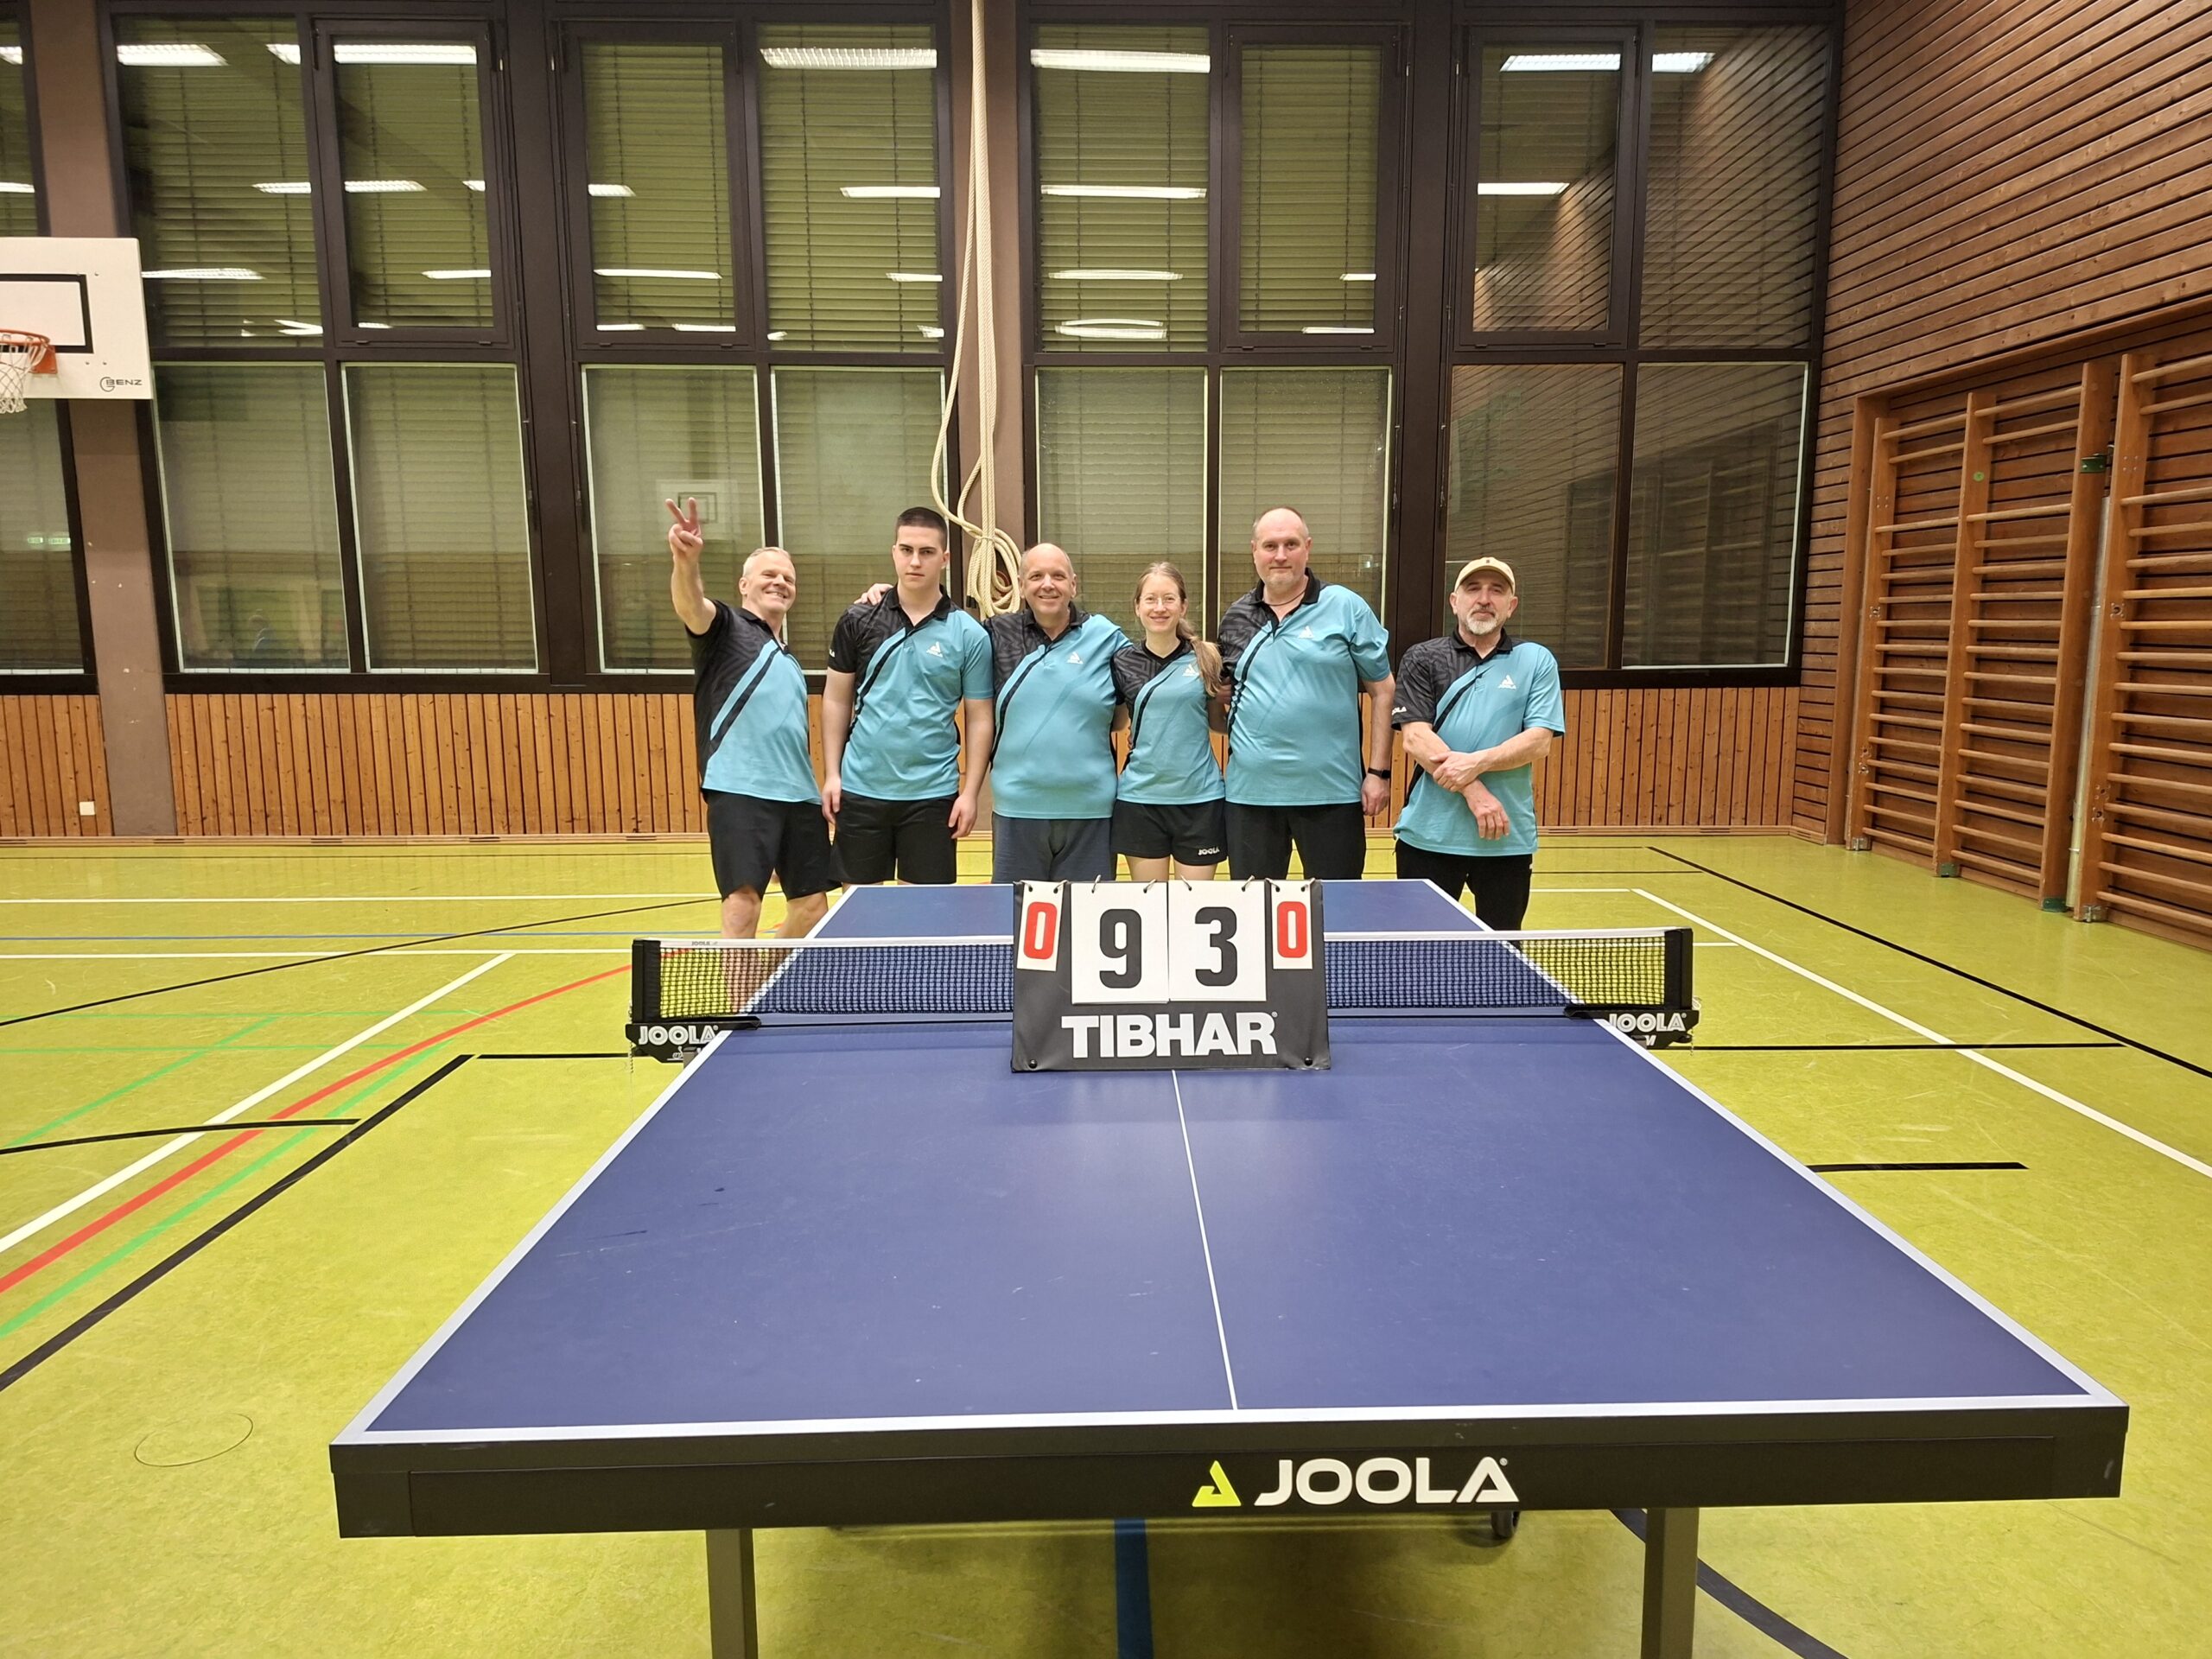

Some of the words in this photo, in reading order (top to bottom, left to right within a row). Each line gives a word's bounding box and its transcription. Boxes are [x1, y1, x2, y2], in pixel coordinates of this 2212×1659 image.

[104, 378, 143, 387] BENZ
[1198, 847, 1220, 855] JOOLA
[1023, 901, 1058, 960] 0
[1099, 908, 1142, 988] 9
[1195, 906, 1237, 987] 3
[1276, 901, 1307, 958] 0
[1609, 1013, 1686, 1033] JOOLA
[638, 1025, 716, 1046] JOOLA
[1061, 1012, 1277, 1058] TIBHAR
[1253, 1457, 1520, 1506] JOOLA
